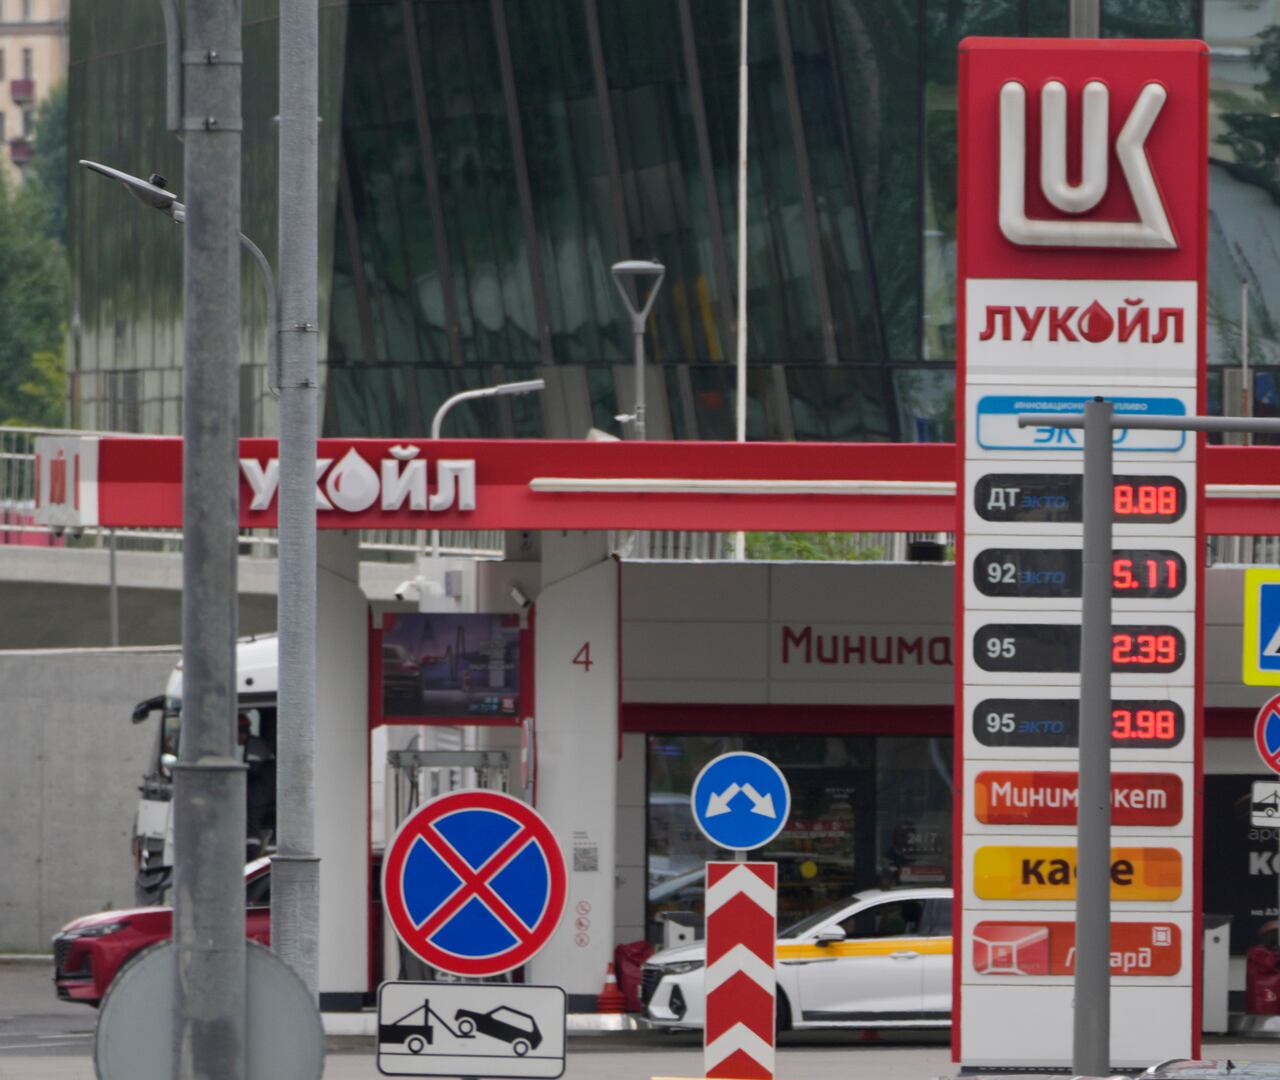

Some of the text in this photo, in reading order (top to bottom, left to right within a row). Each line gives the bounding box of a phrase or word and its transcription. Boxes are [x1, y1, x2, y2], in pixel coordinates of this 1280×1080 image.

[979, 297, 1184, 343] ЛУКОЙЛ
[987, 488, 1020, 510] ДТ
[987, 563, 1016, 583] 92
[572, 641, 593, 671] 4
[986, 638, 1016, 658] 95
[986, 713, 1015, 733] 95
[991, 781, 1167, 809] Минимкет
[1022, 858, 1134, 885] кае
